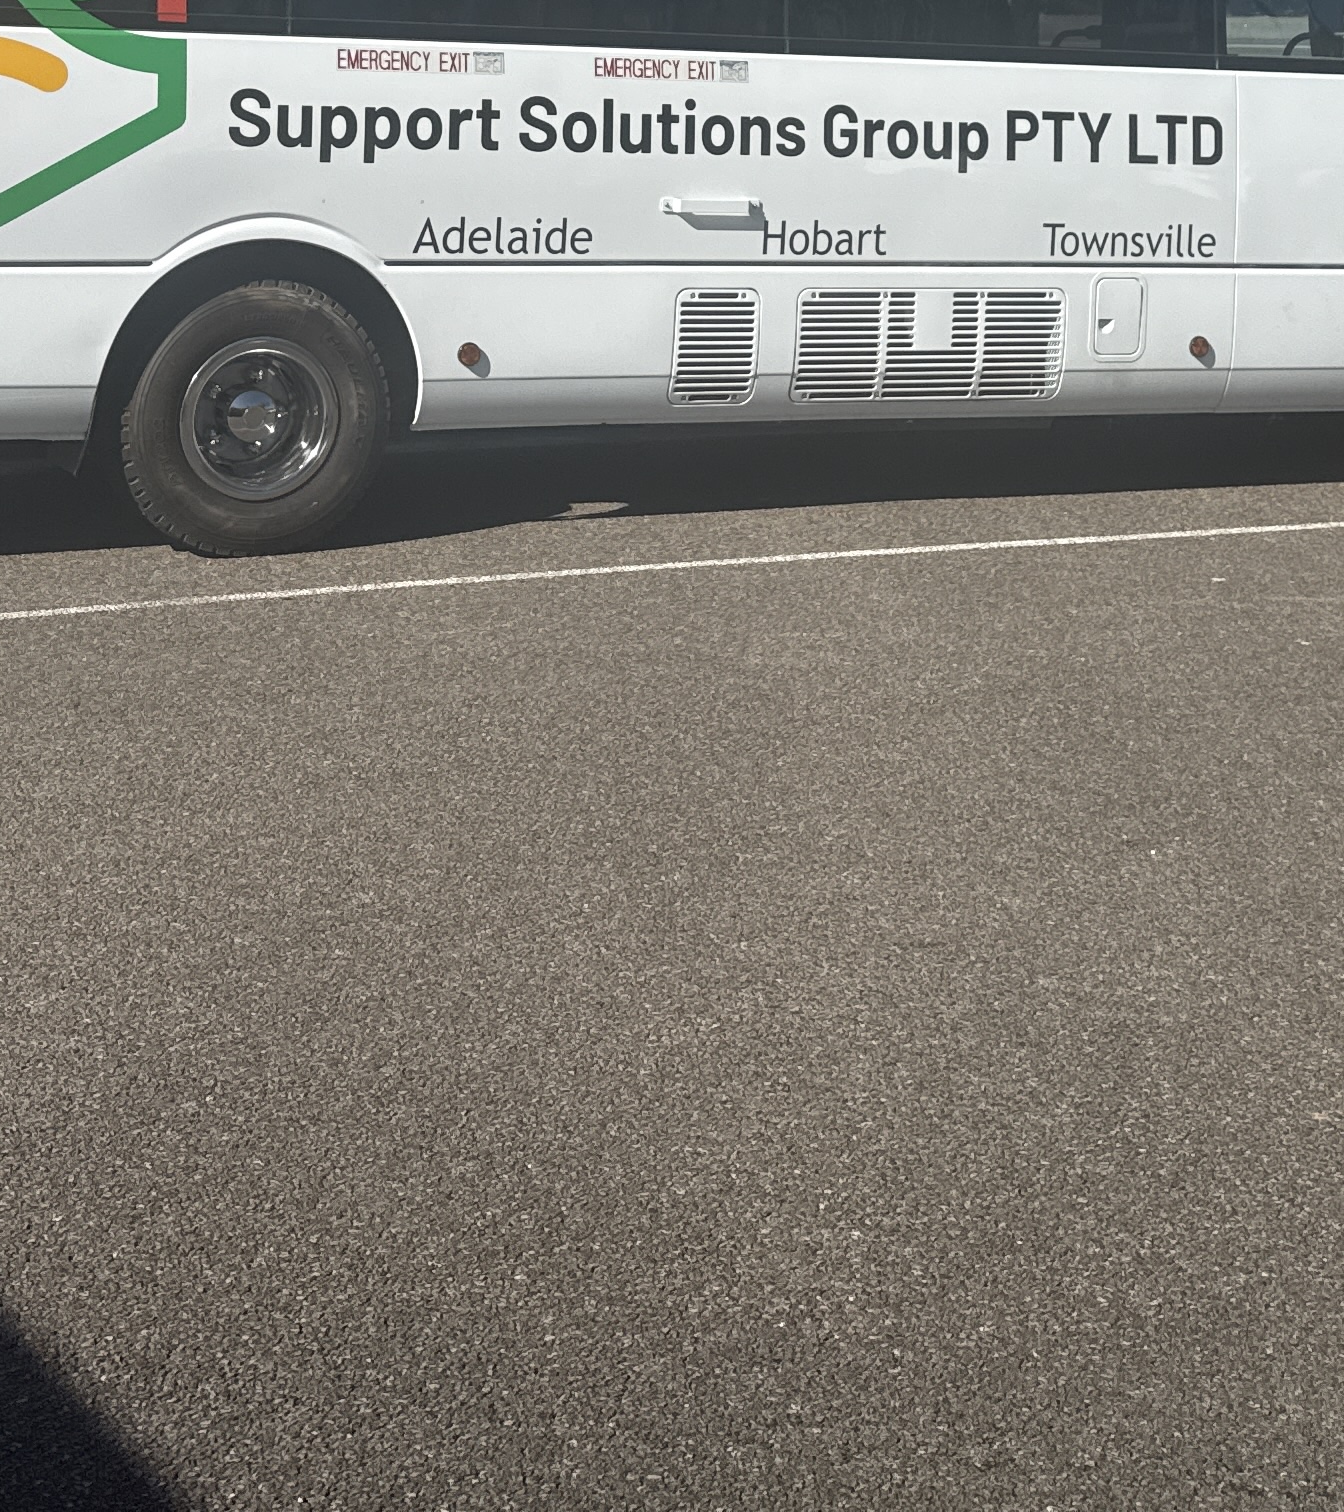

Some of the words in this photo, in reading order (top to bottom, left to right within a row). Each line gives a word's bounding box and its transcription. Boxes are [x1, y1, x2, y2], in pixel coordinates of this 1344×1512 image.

[337, 48, 431, 71] EMERGENCY
[439, 51, 470, 73] EXIT
[594, 57, 680, 79] EMERGENCY
[687, 60, 716, 81] EXIT
[228, 87, 501, 163] Support
[518, 95, 806, 158] Solutions
[823, 104, 990, 174] Group
[1006, 109, 1112, 164] PTY
[1128, 113, 1224, 166] LTD
[412, 216, 594, 255] Adelaide
[761, 219, 887, 257] Hobart
[1042, 222, 1218, 258] Townsville
